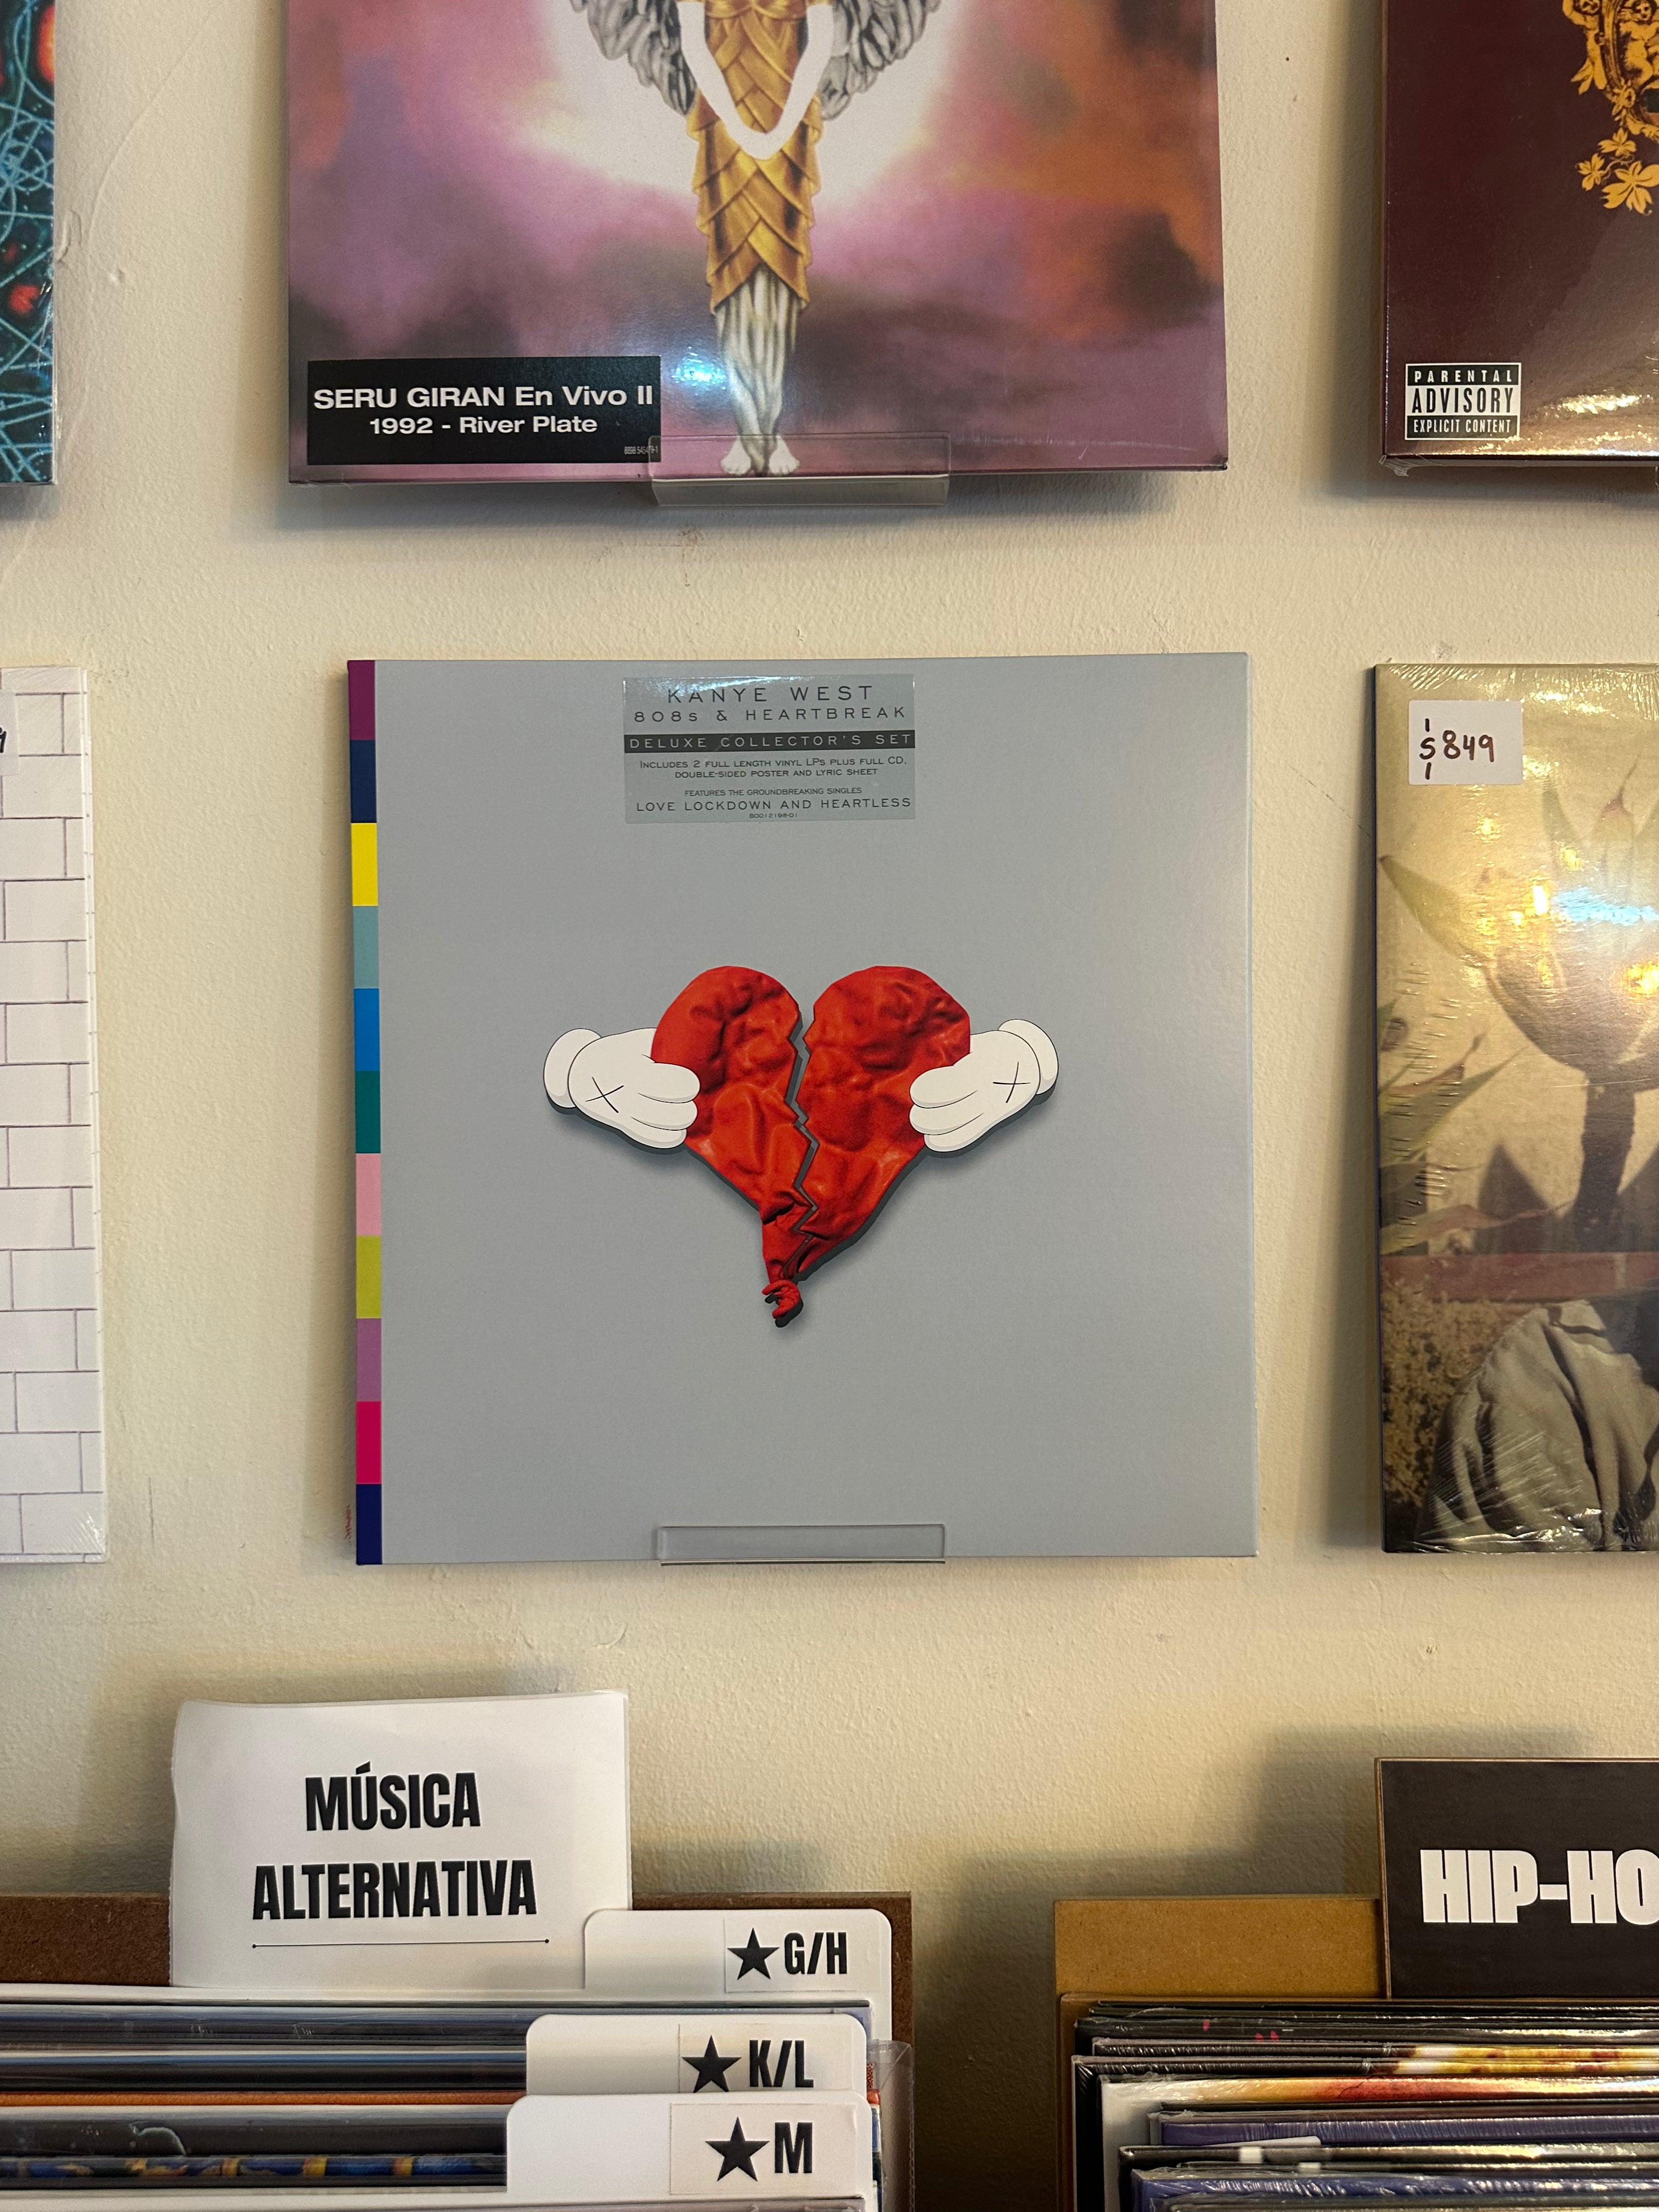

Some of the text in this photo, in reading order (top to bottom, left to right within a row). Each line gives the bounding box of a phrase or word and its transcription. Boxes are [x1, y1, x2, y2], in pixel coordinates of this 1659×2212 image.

[1414, 370, 1512, 383] PARENTAL
[314, 386, 653, 410] SERU GIRAN En Vivo II
[1412, 387, 1514, 413] ADVISORY
[370, 417, 434, 435] 1992
[460, 416, 526, 434] River
[533, 415, 598, 433] Plate
[1413, 419, 1511, 433] EXPLICIT CONTENT
[668, 686, 872, 703] KANYE WEST
[716, 710, 728, 721] &
[746, 707, 905, 721] HEARTBREAK
[630, 734, 911, 748] DELUXE COLLECTOR'S SET
[1419, 718, 1494, 780] $849
[693, 760, 701, 768] 2
[747, 788, 824, 796] GROUNDBREAKING
[637, 798, 911, 811] LOVE LOCKDOWN AND HEARTLESS
[306, 1761, 481, 1831] MÚSICA
[252, 1859, 537, 1920] ALTERNATIVA
[784, 1932, 848, 1975] G/H
[749, 2040, 814, 2088] K/L
[774, 2122, 813, 2174] M
